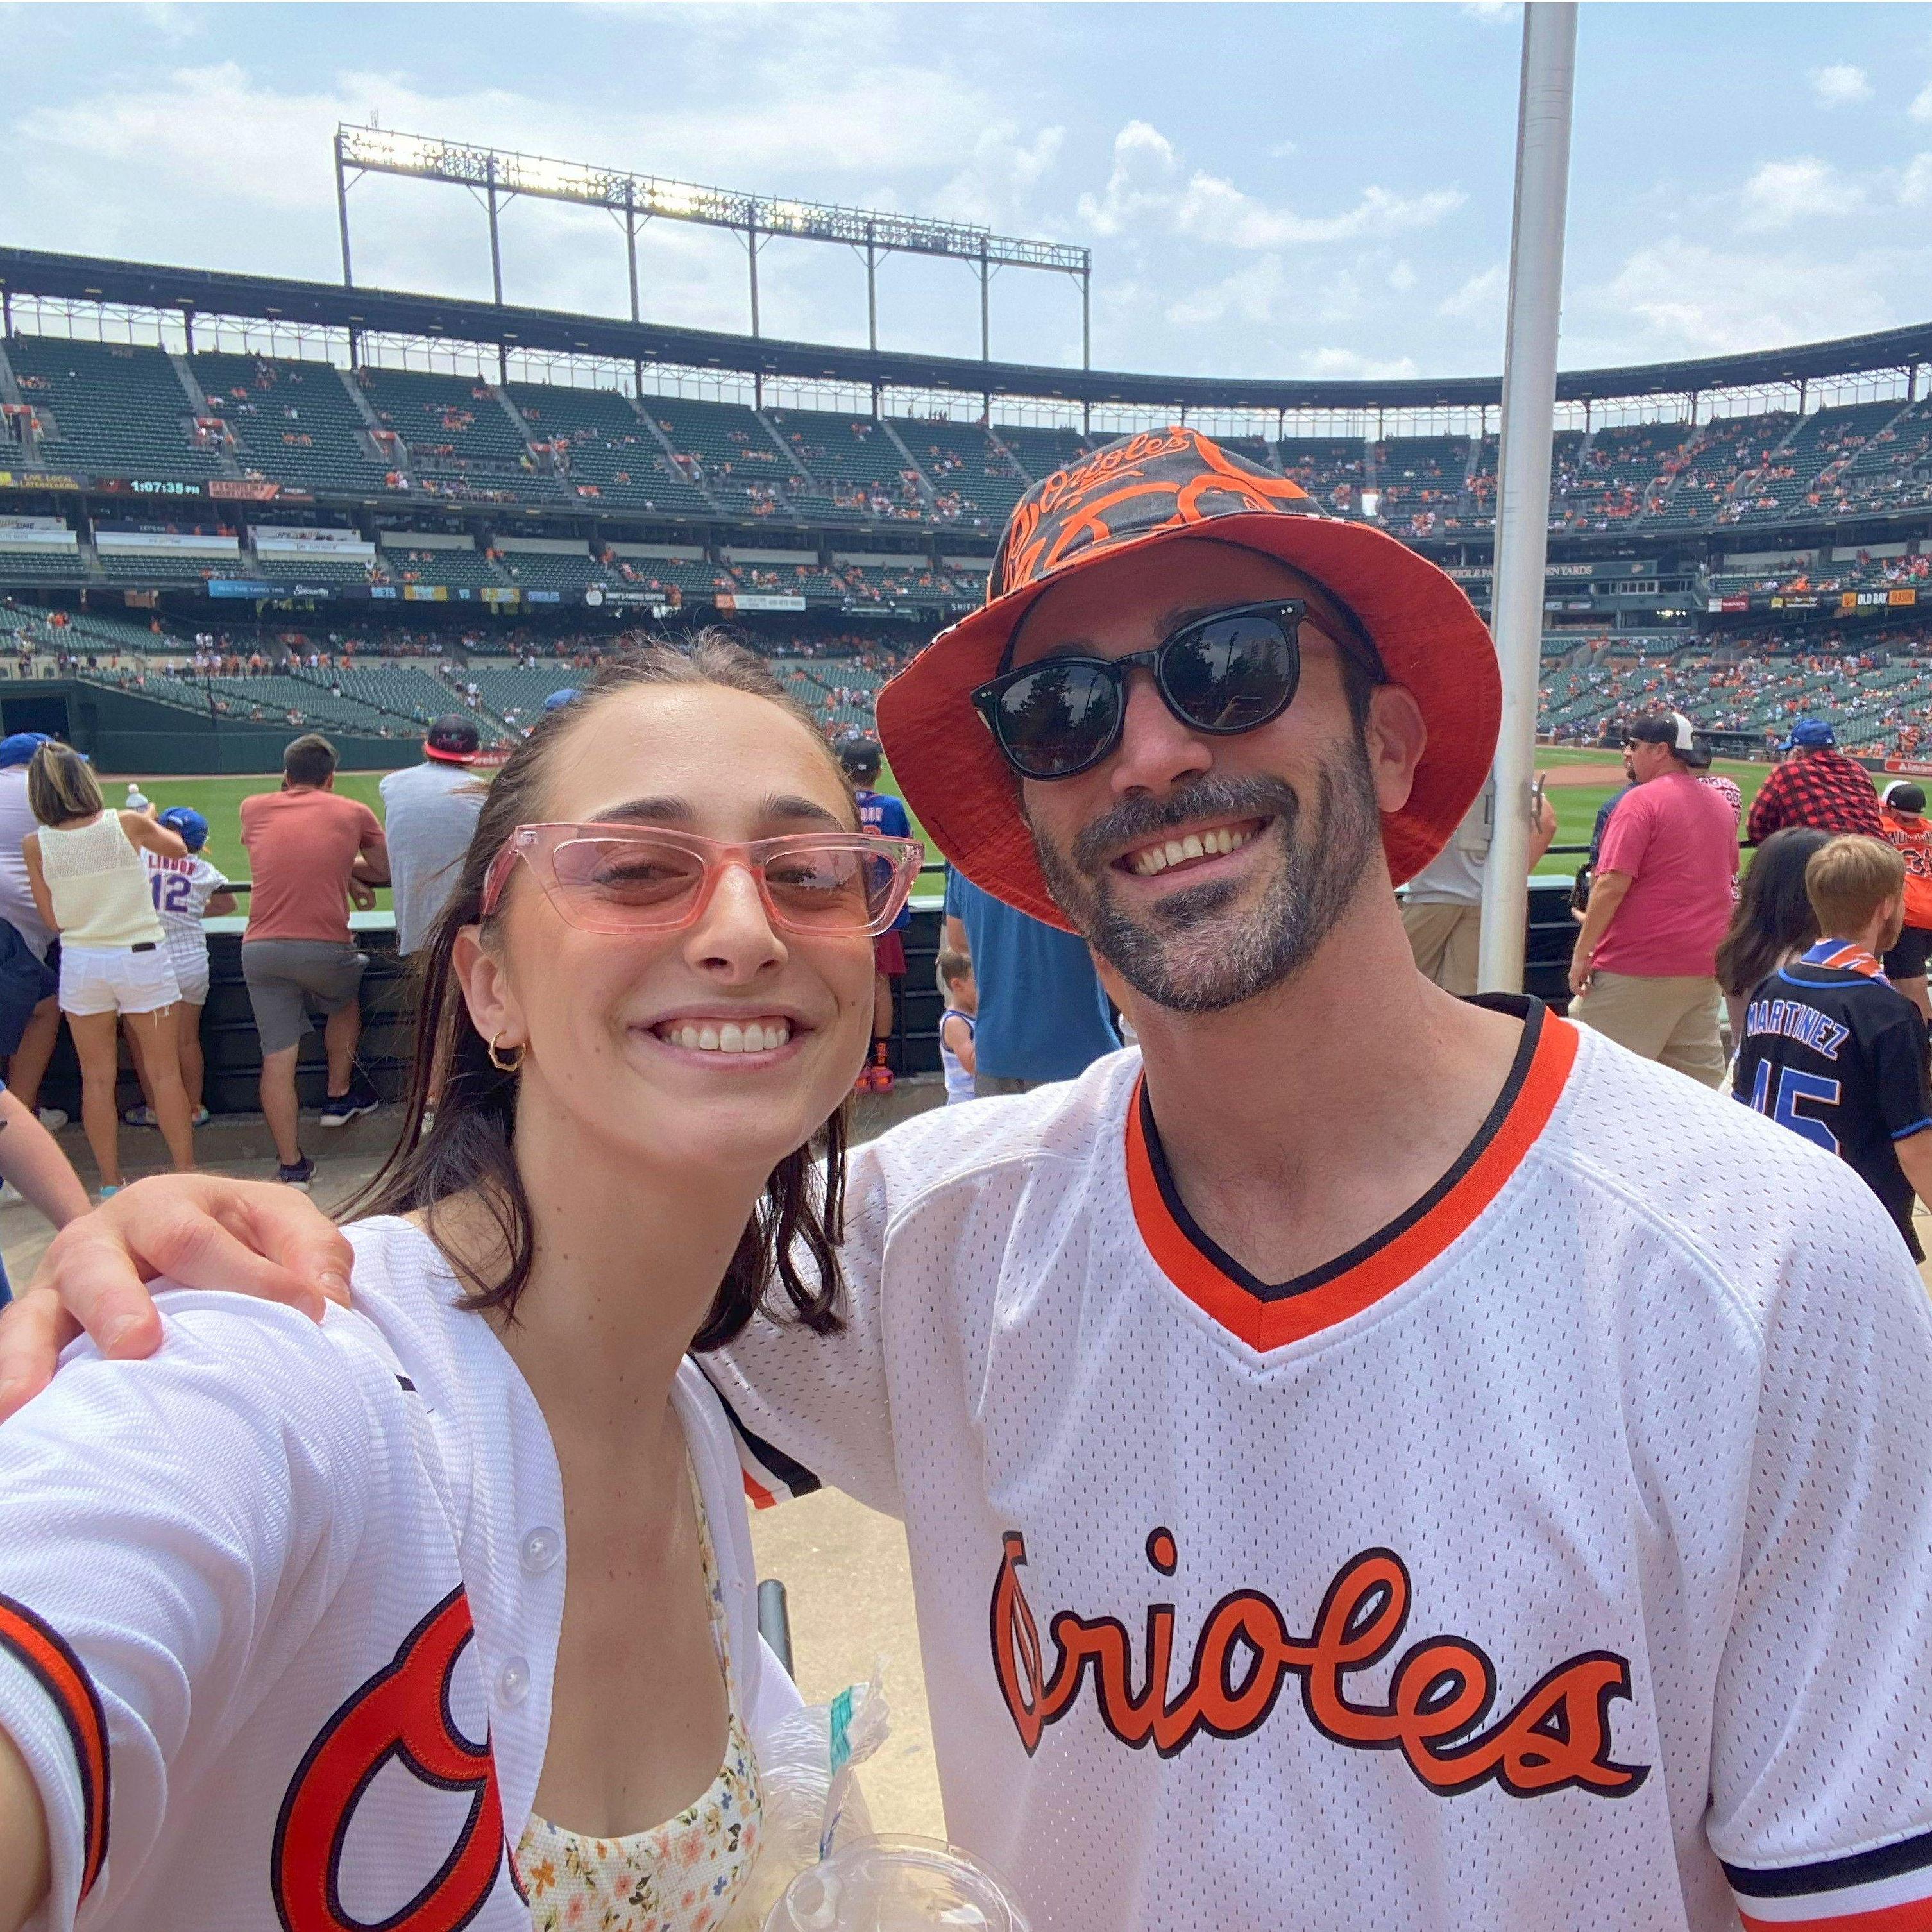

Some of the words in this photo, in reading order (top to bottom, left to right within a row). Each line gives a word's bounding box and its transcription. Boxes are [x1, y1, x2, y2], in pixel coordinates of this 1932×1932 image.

[1039, 434, 1191, 514] Orioles
[1857, 593, 1872, 605] OLD
[1873, 592, 1888, 604] BAY
[150, 872, 191, 913] 12
[1747, 999, 1849, 1062] MARTINEZ
